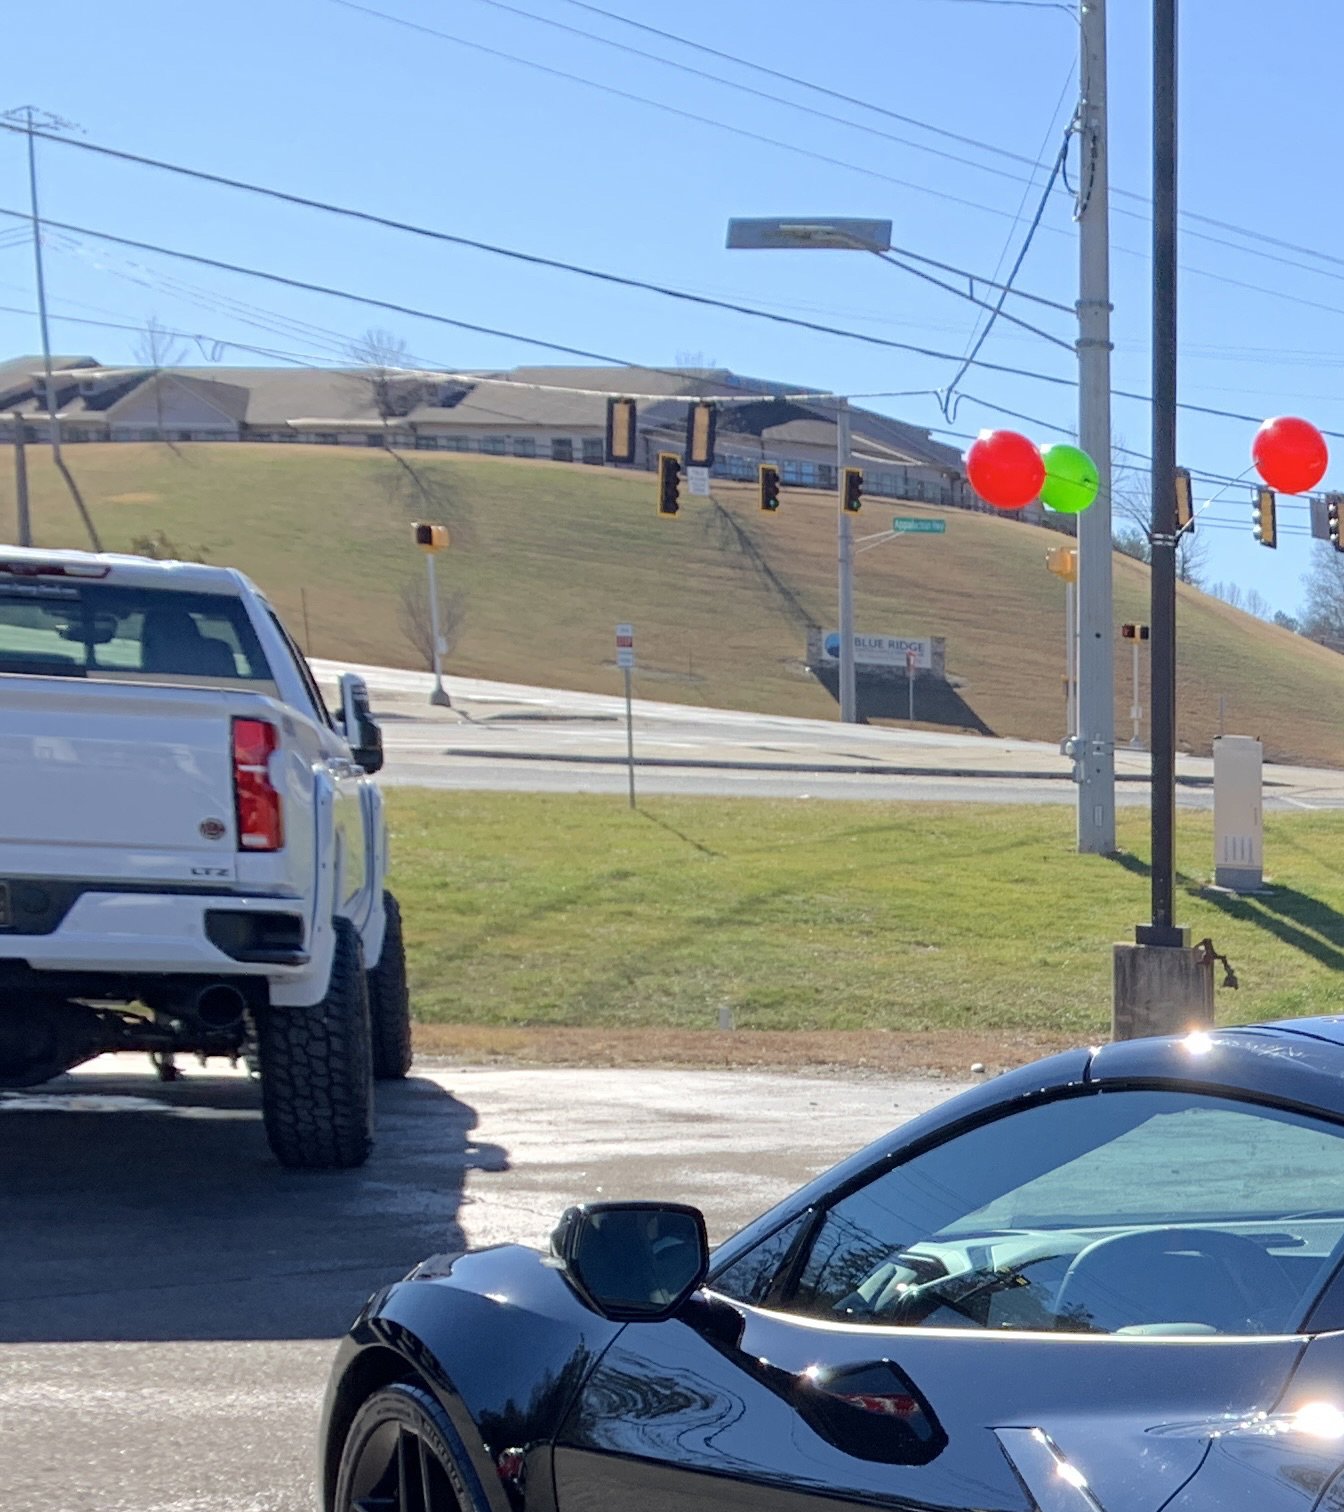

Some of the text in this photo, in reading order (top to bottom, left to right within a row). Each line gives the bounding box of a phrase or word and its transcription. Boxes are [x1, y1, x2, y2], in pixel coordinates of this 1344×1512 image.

[854, 637, 884, 649] BLUE
[888, 640, 925, 653] RIDGE
[191, 867, 229, 877] LTZ
